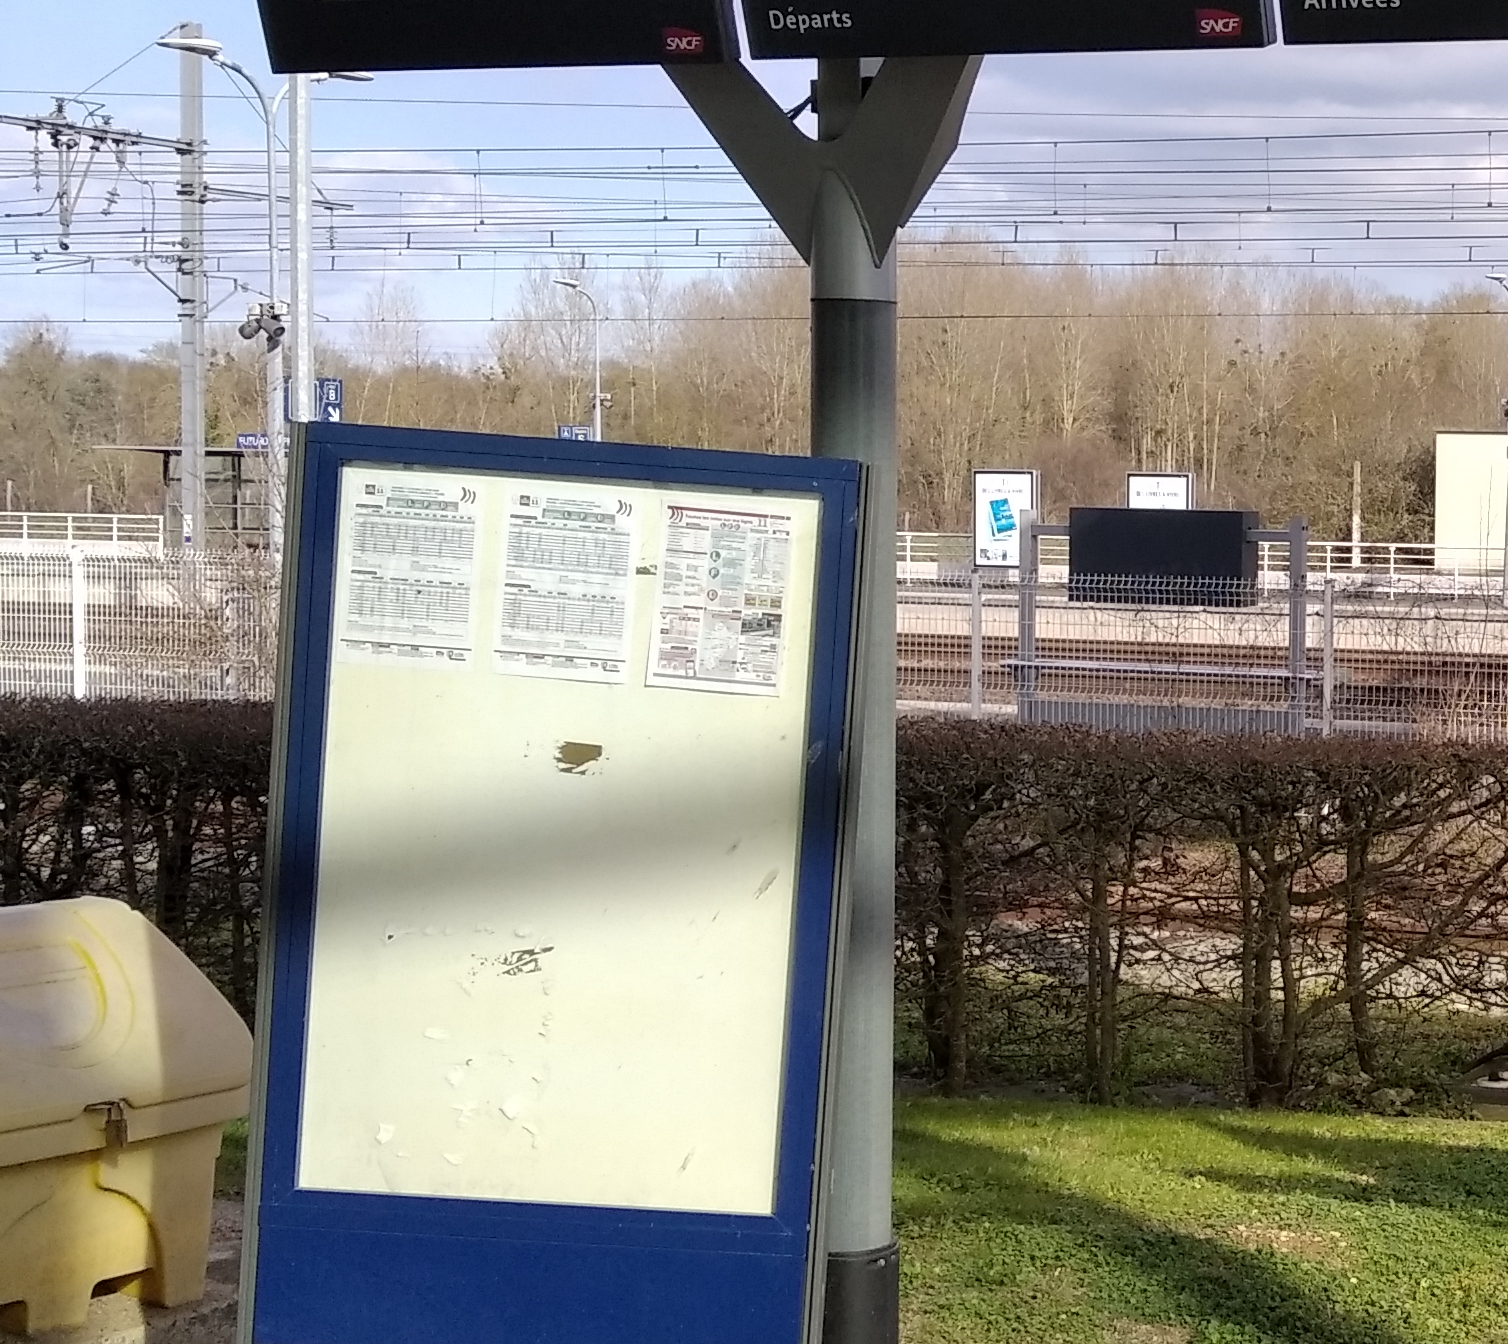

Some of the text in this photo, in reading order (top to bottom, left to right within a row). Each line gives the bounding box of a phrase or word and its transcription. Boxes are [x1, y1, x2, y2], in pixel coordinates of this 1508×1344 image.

[768, 4, 852, 32] Départs
[1199, 17, 1240, 34] SNCF
[665, 35, 702, 52] SNCF
